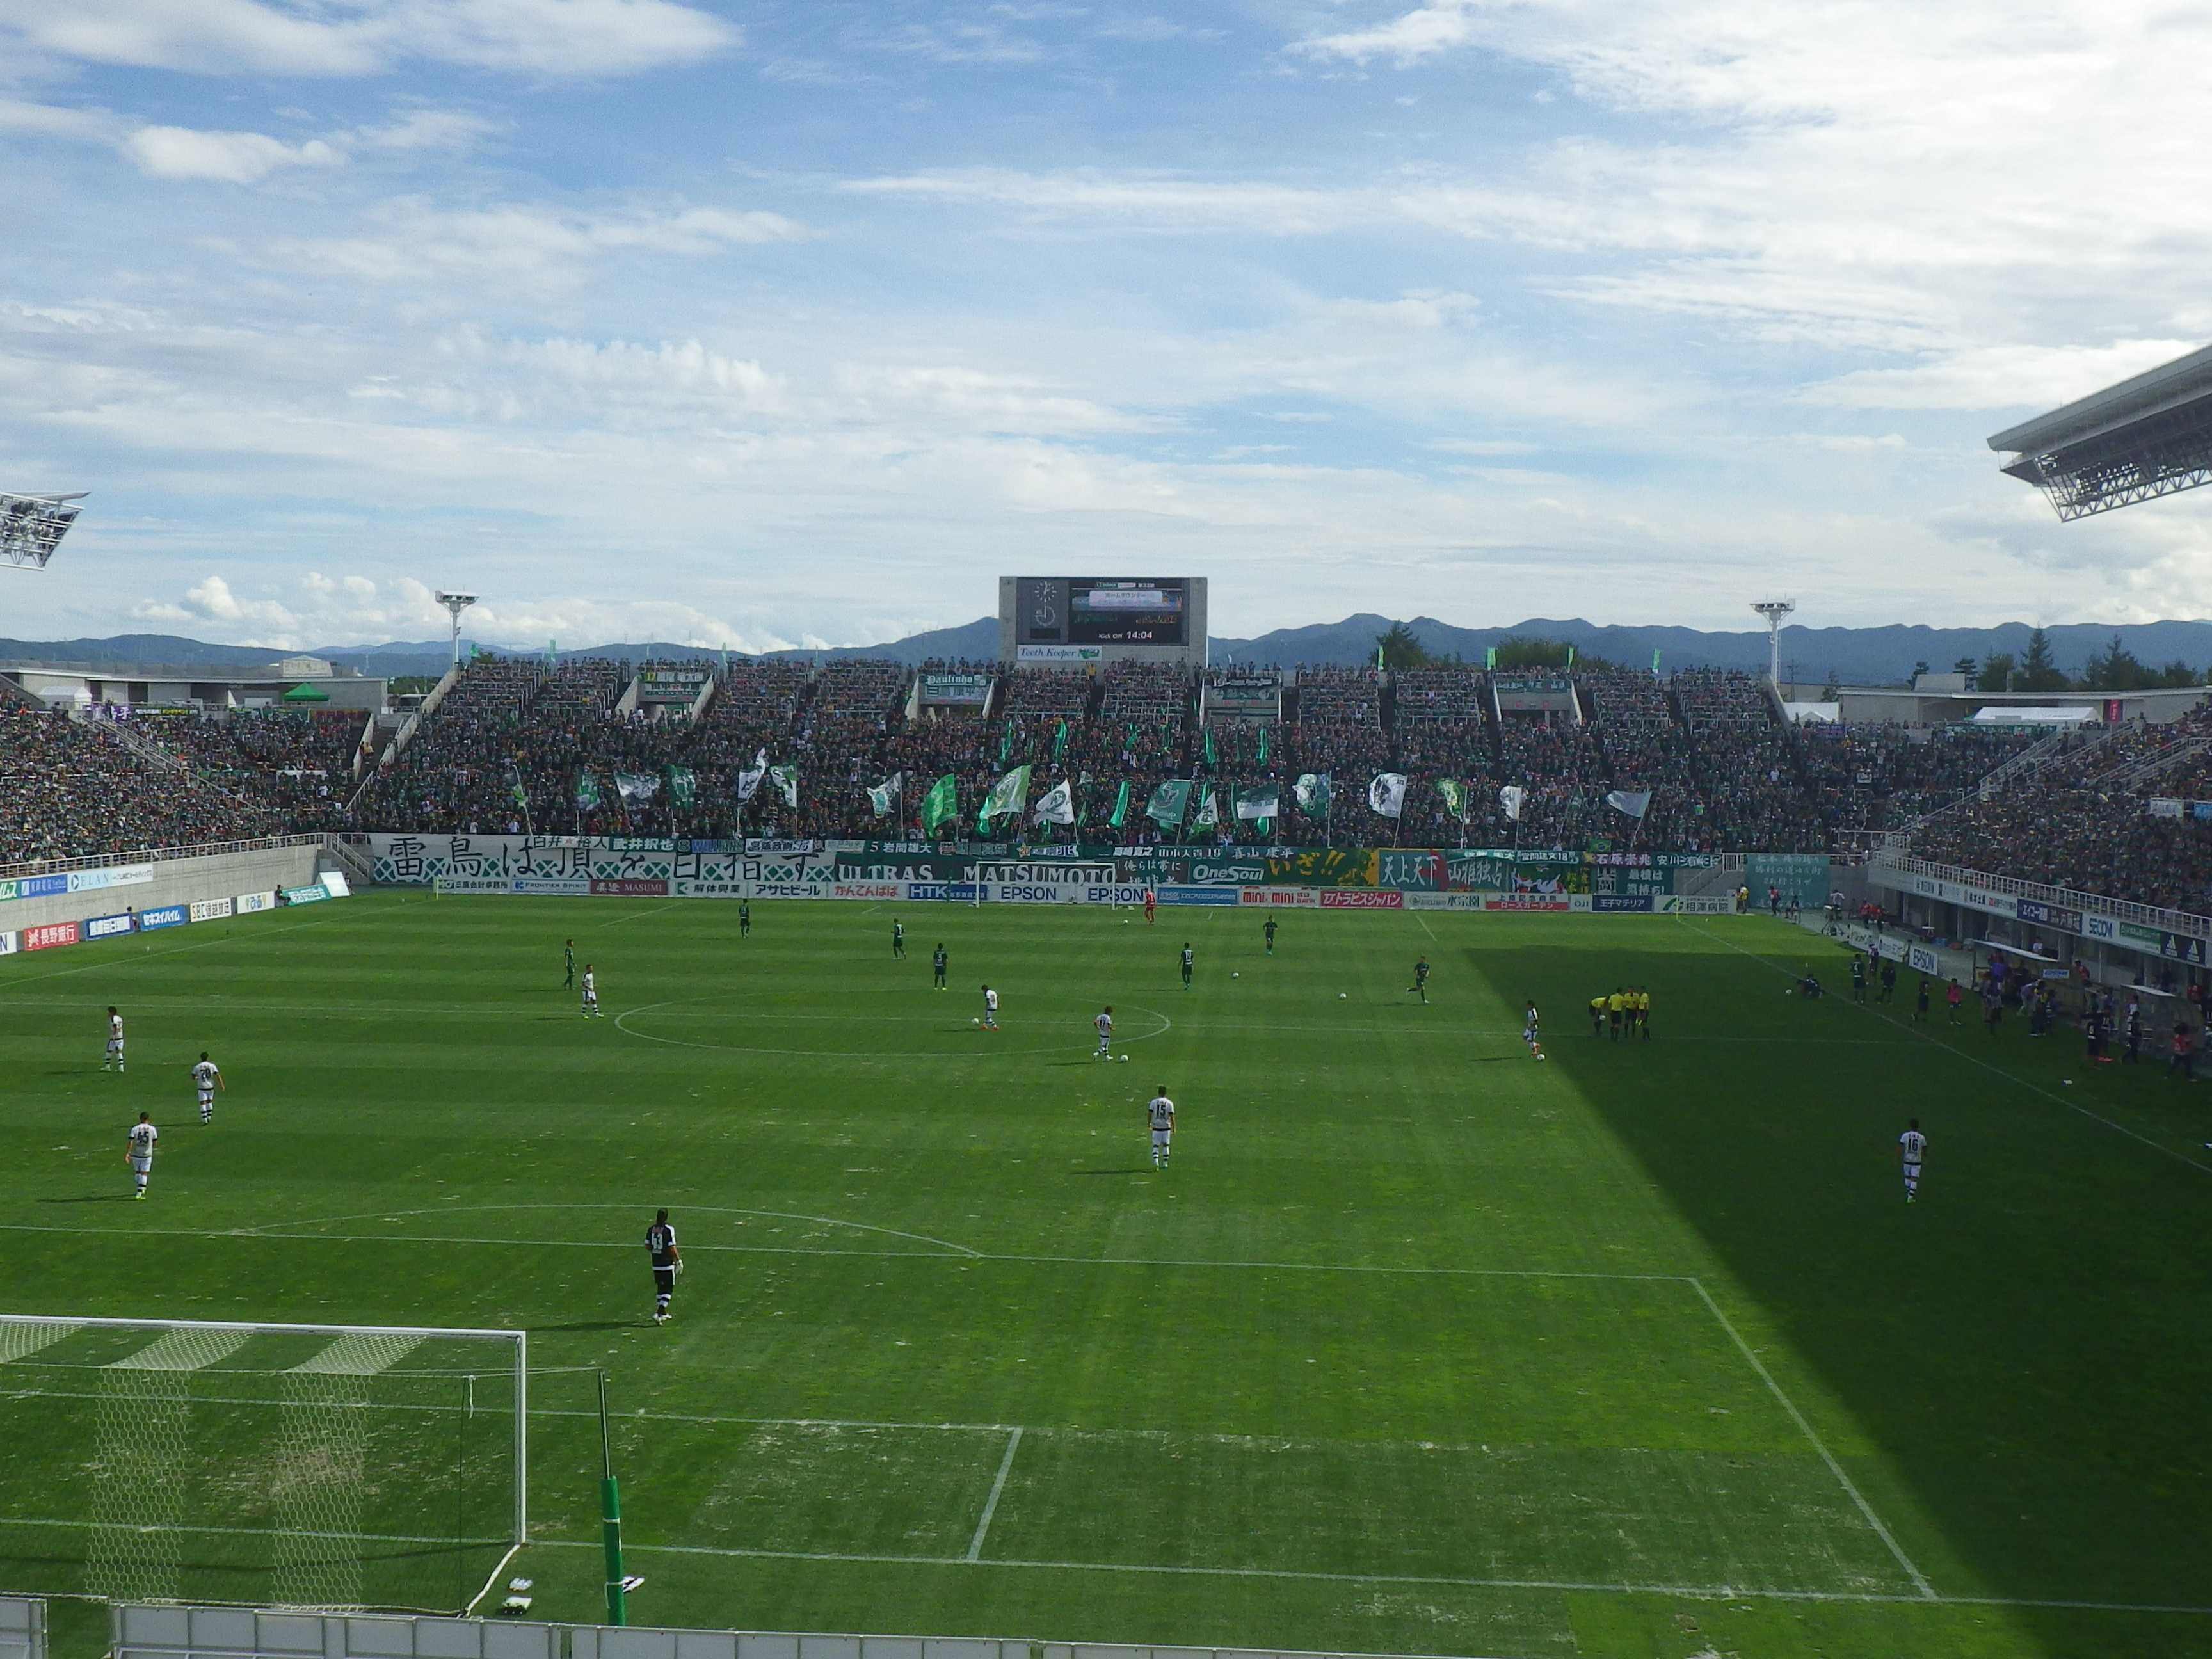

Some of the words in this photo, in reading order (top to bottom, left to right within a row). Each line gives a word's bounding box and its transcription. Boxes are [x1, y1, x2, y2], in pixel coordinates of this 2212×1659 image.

[1021, 648, 1043, 657] Teeth
[1046, 648, 1076, 659] Keeper
[928, 675, 973, 684] Paulinho
[613, 838, 674, 851] 武井択也
[963, 863, 1116, 886] MATSUMOTO
[1192, 864, 1265, 882] OneSoul
[624, 883, 662, 892] MASUMI
[755, 885, 821, 895] アサヒビール
[1000, 886, 1057, 901] EPSON
[1088, 888, 1144, 902] EPSON
[1599, 899, 1645, 908] 王子マテリア
[40, 924, 74, 945] 長野銀行
[1908, 1138, 1919, 1151] 16
